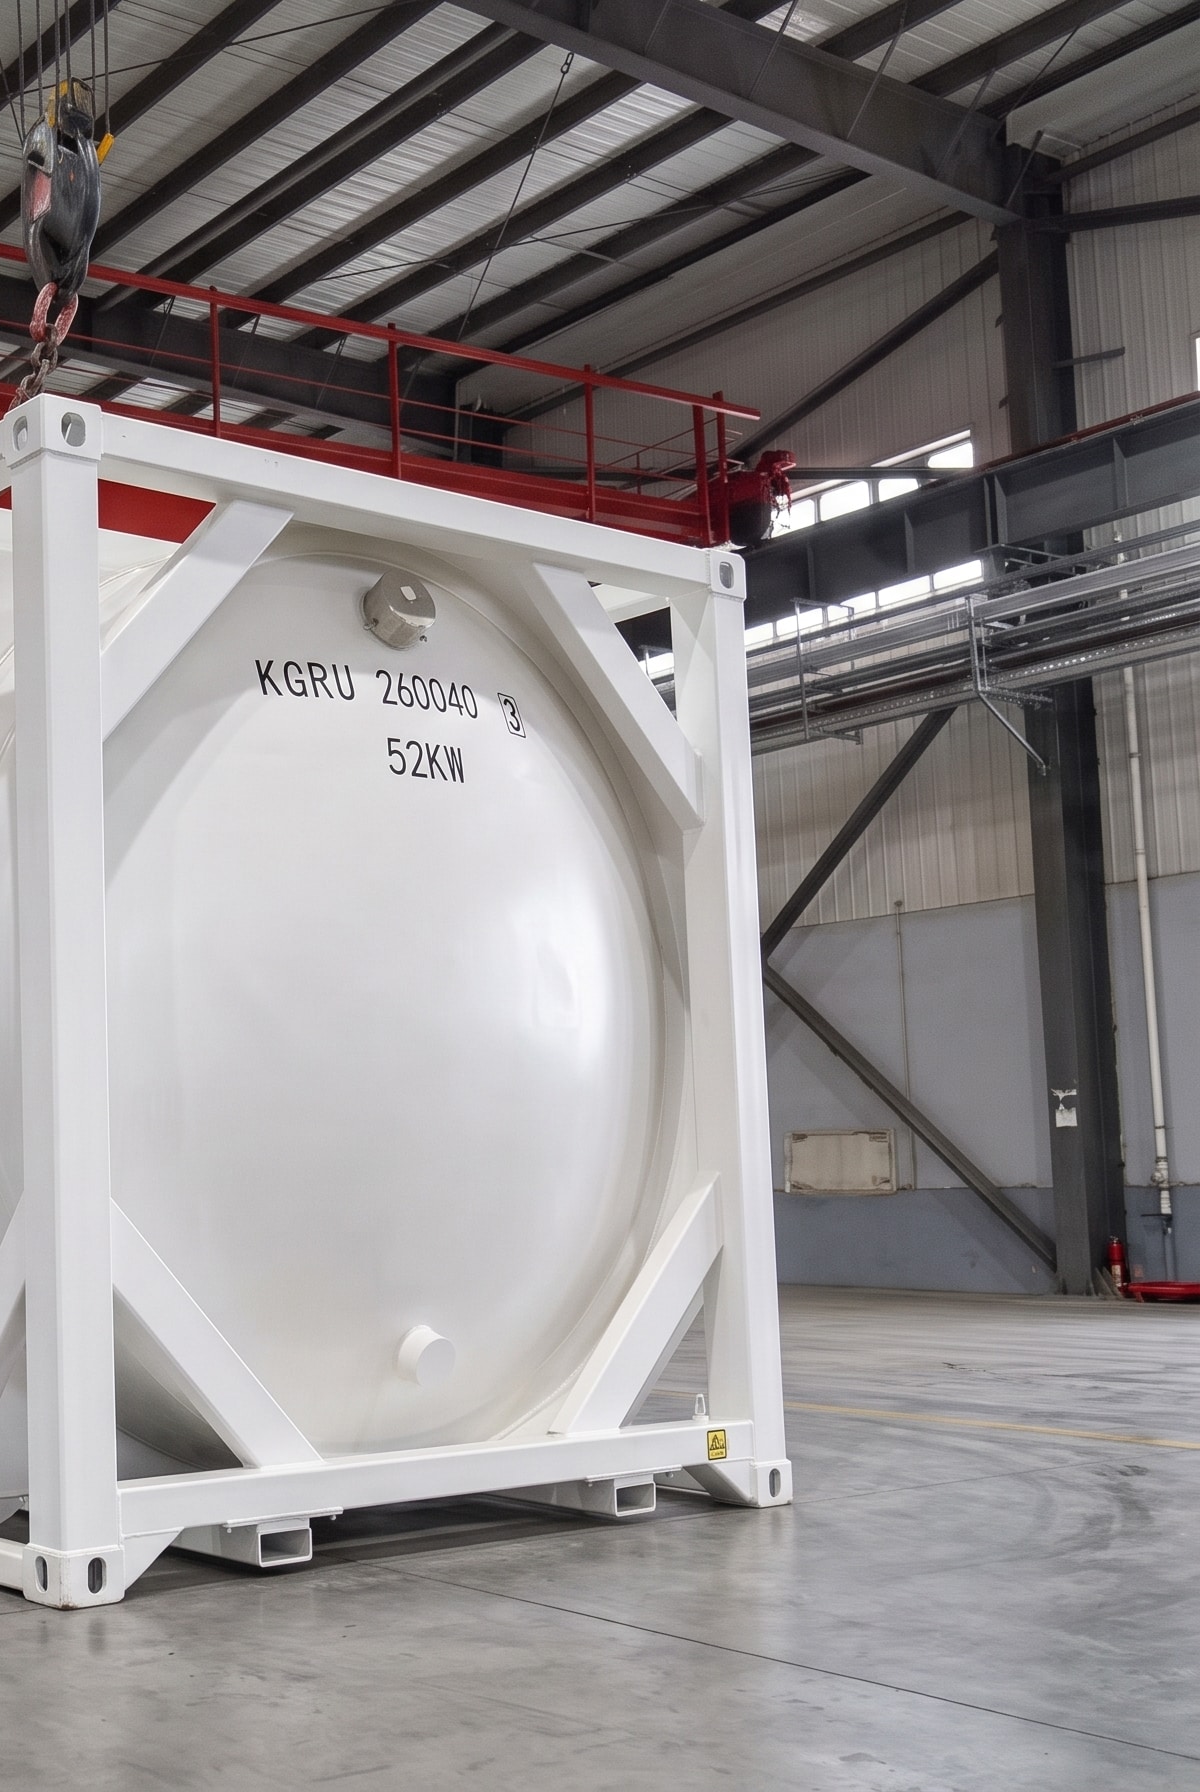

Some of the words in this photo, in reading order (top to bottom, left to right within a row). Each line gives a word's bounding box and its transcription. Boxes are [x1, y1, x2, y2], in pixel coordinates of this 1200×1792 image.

[255, 659, 355, 700] KGRU
[375, 669, 478, 719] 260040
[503, 698, 521, 732] 3
[387, 737, 465, 783] 52KW
